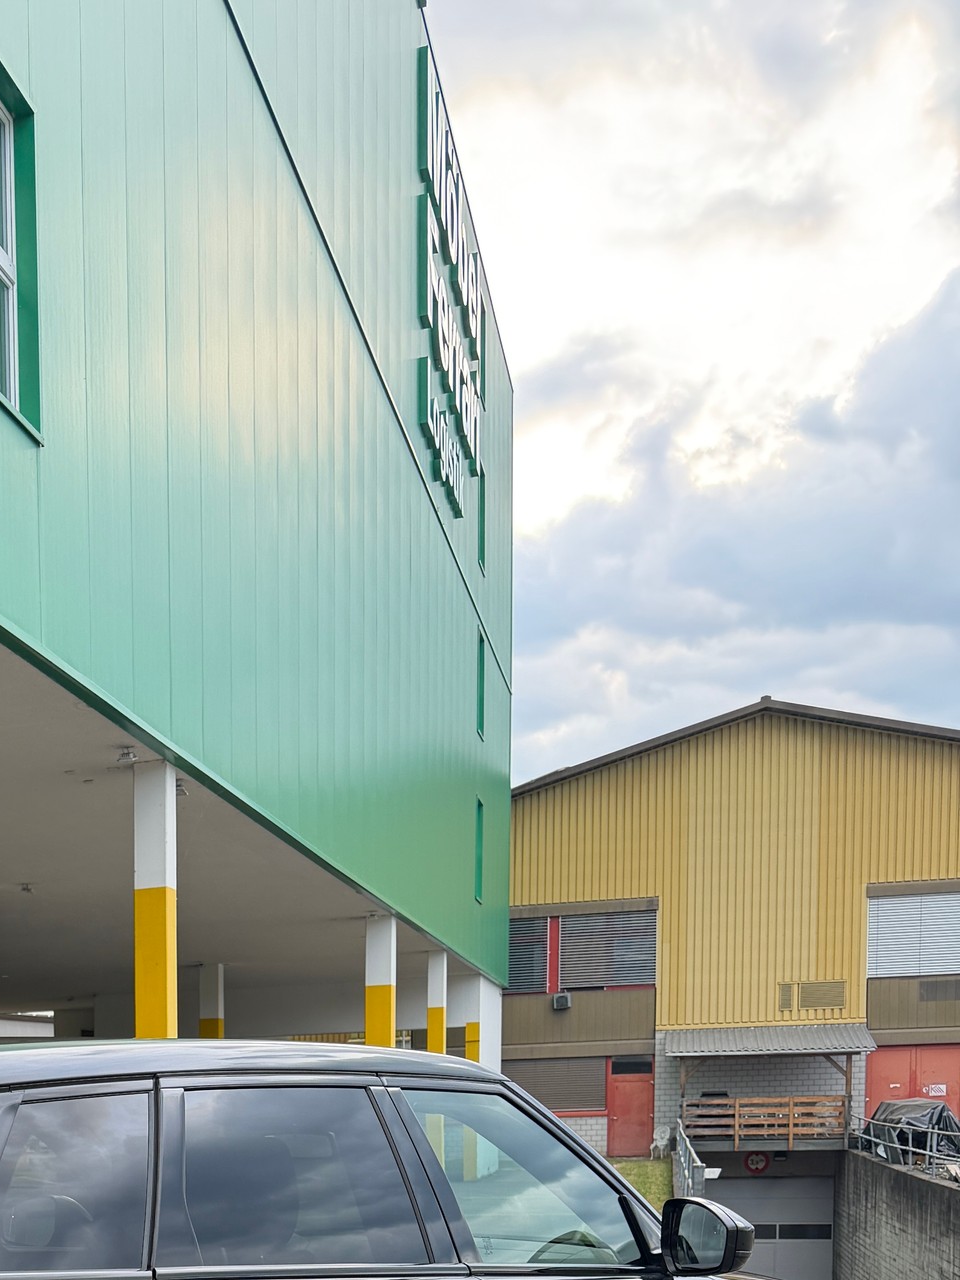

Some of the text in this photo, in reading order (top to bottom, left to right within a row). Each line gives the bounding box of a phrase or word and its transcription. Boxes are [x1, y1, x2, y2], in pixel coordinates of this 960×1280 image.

[426, 45, 482, 361] Möbel
[426, 192, 481, 477] Ferrari
[426, 355, 464, 518] Logistik
